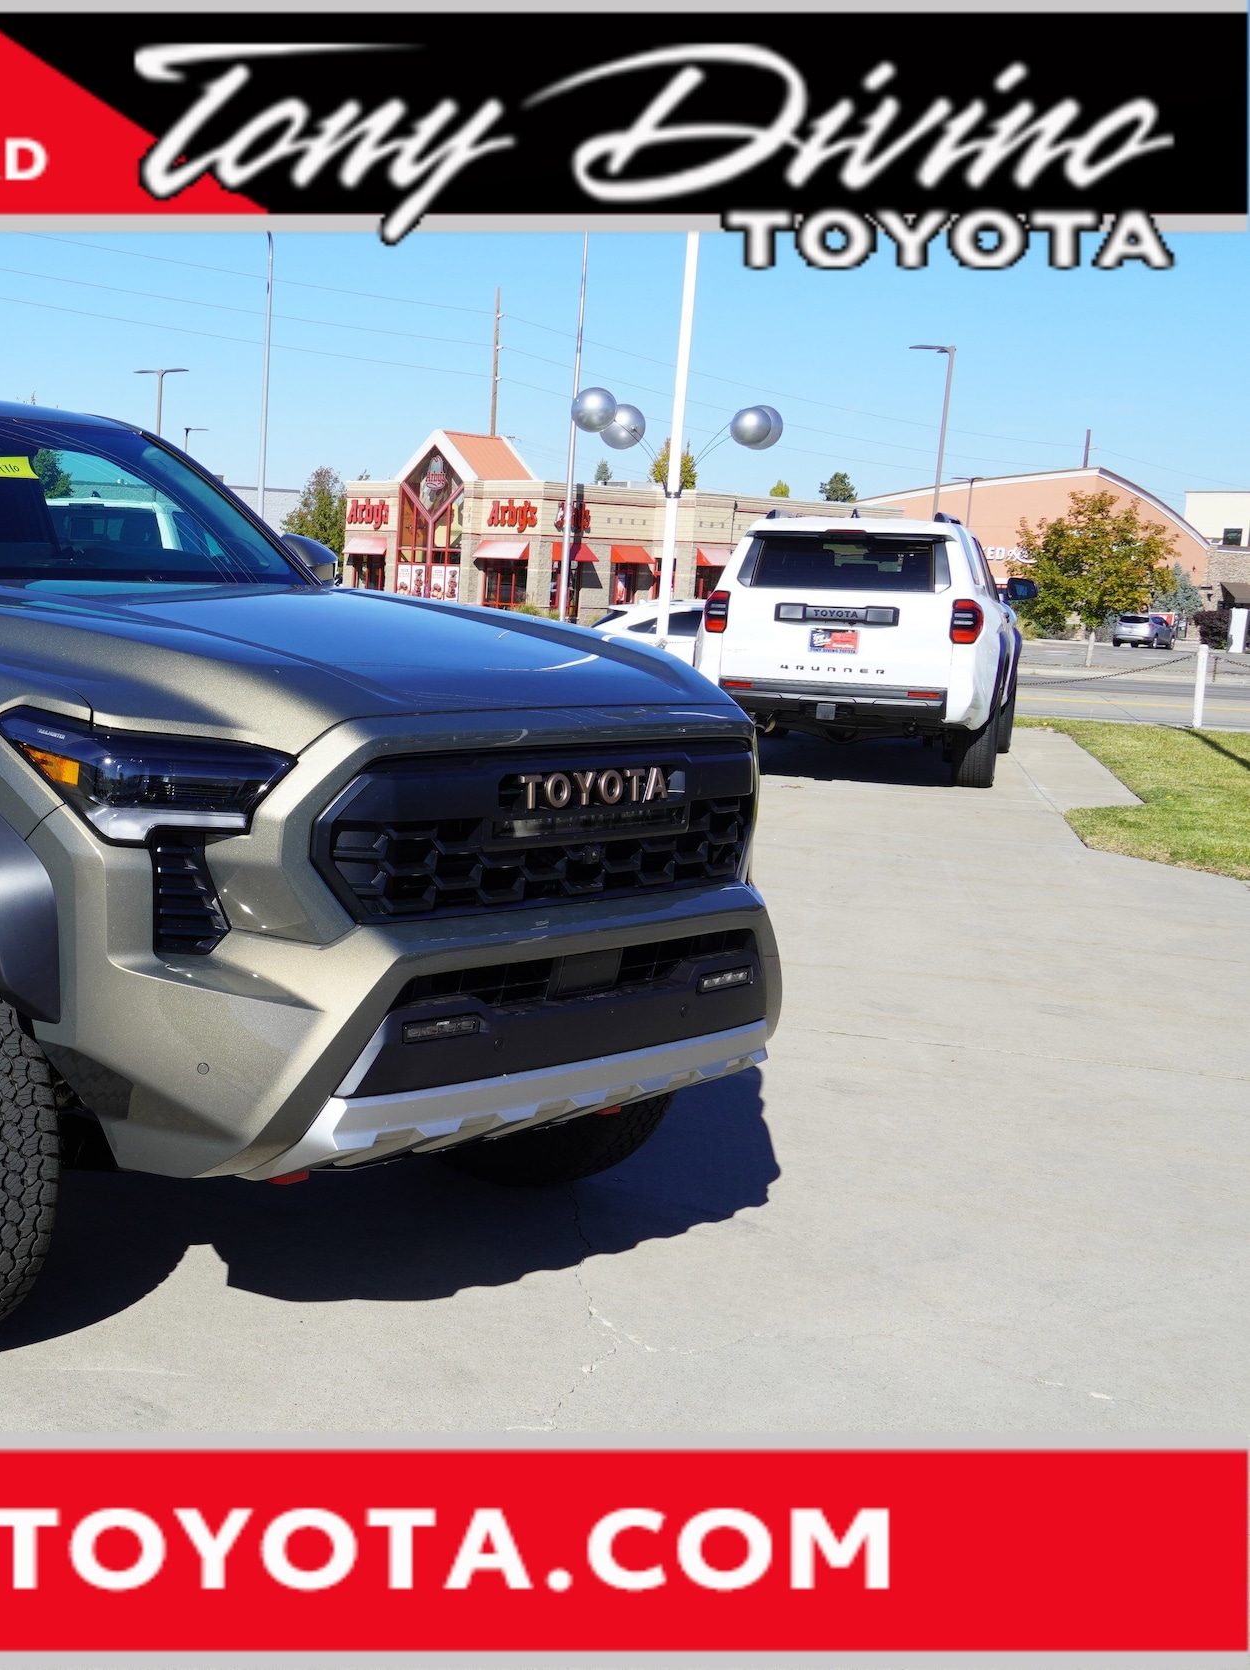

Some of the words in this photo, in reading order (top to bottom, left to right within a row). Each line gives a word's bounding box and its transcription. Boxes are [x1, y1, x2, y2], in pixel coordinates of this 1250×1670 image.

[347, 498, 389, 530] Arby's
[487, 498, 538, 533] Arby's
[813, 609, 858, 618] TOYOTA
[780, 664, 885, 675] 4RUNNER
[519, 767, 668, 810] TOYOTA
